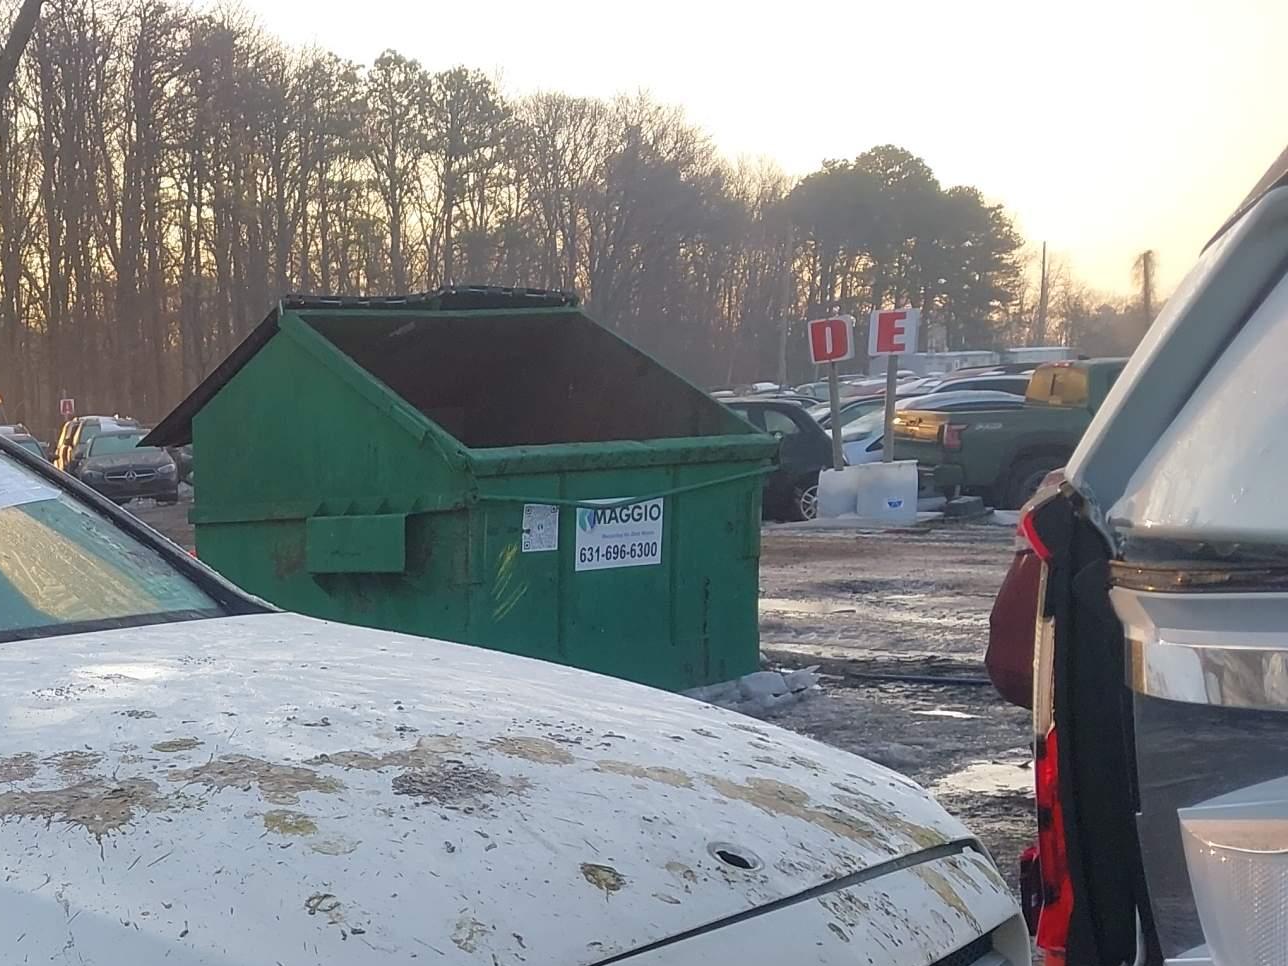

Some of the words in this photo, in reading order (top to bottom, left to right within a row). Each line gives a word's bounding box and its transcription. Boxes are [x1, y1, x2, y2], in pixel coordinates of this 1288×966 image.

[811, 320, 848, 361] D
[877, 312, 907, 352] E
[594, 504, 661, 524] MAGGIO
[580, 542, 657, 563] 631-696-6300
